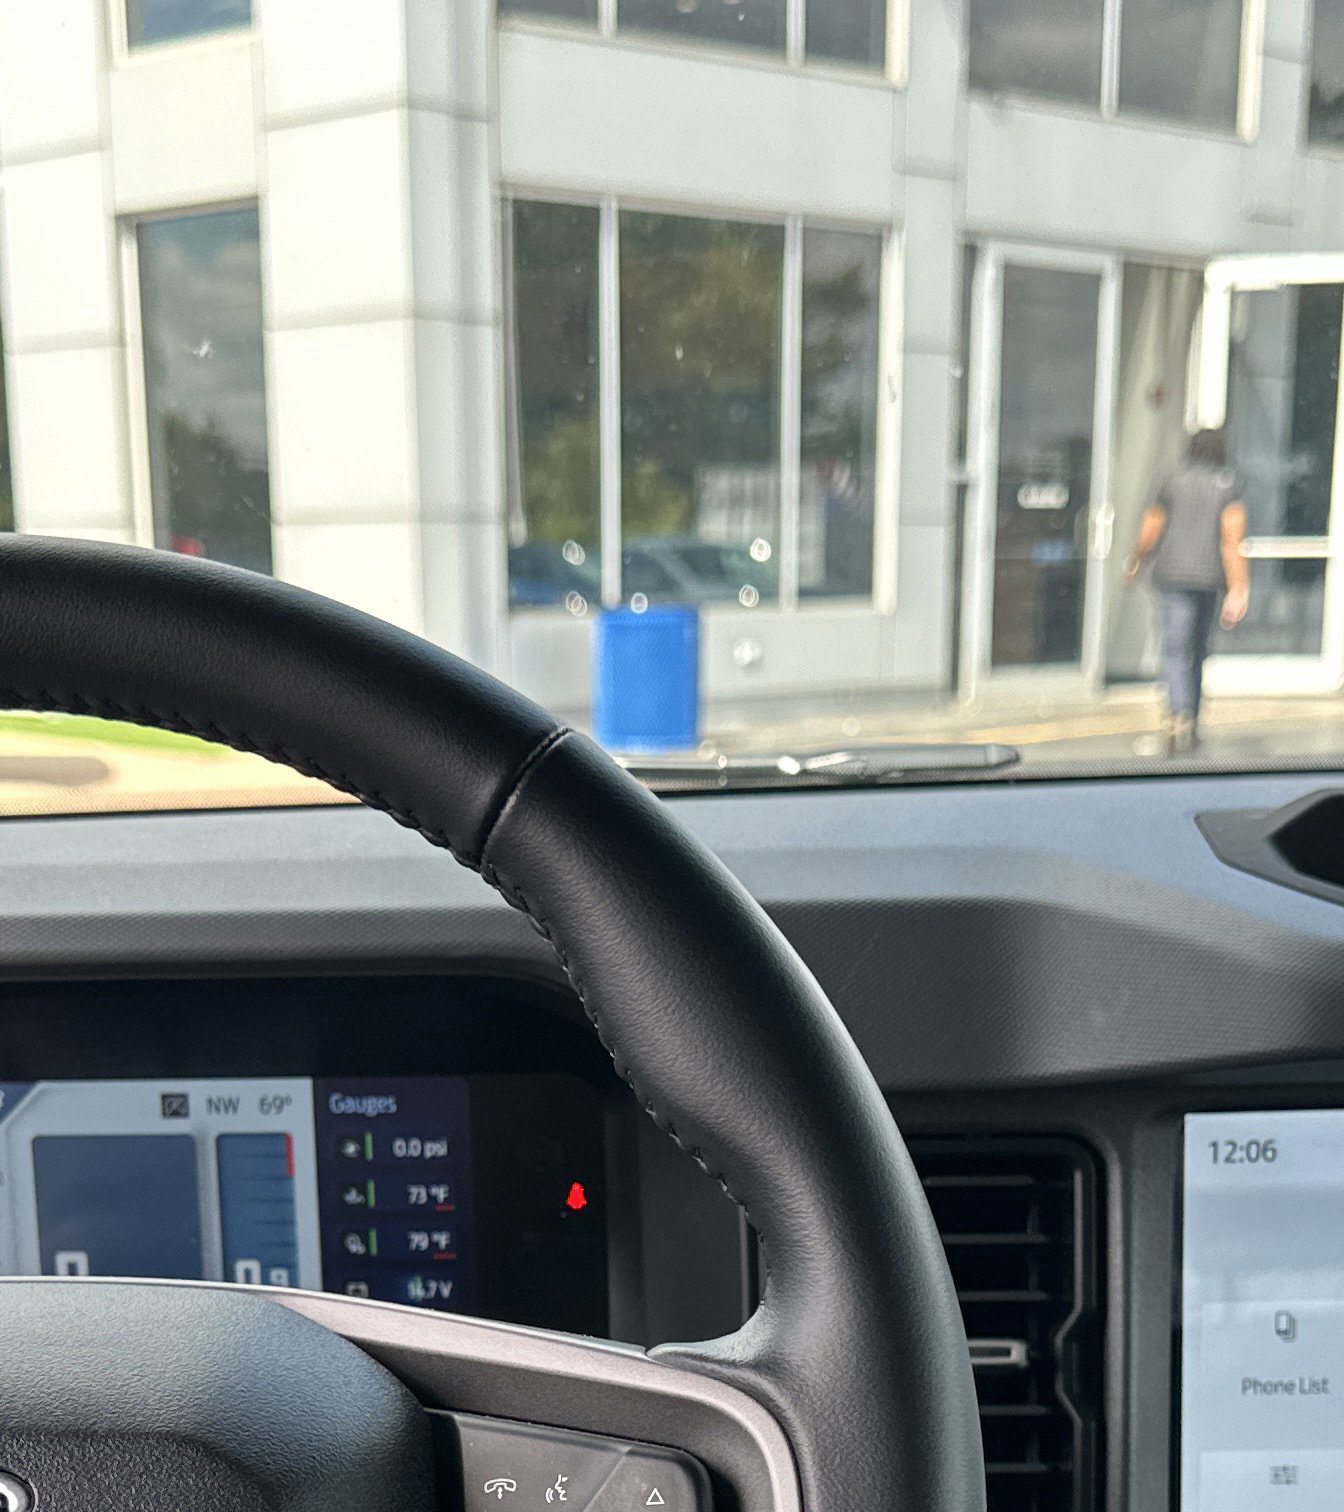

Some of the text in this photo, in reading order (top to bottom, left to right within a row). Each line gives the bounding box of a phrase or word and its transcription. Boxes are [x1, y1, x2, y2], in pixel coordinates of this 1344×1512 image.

[207, 1095, 241, 1116] NW
[328, 1091, 398, 1118] Gauges
[1208, 1139, 1278, 1164] 12:06
[1241, 1376, 1330, 1395] Phone List
